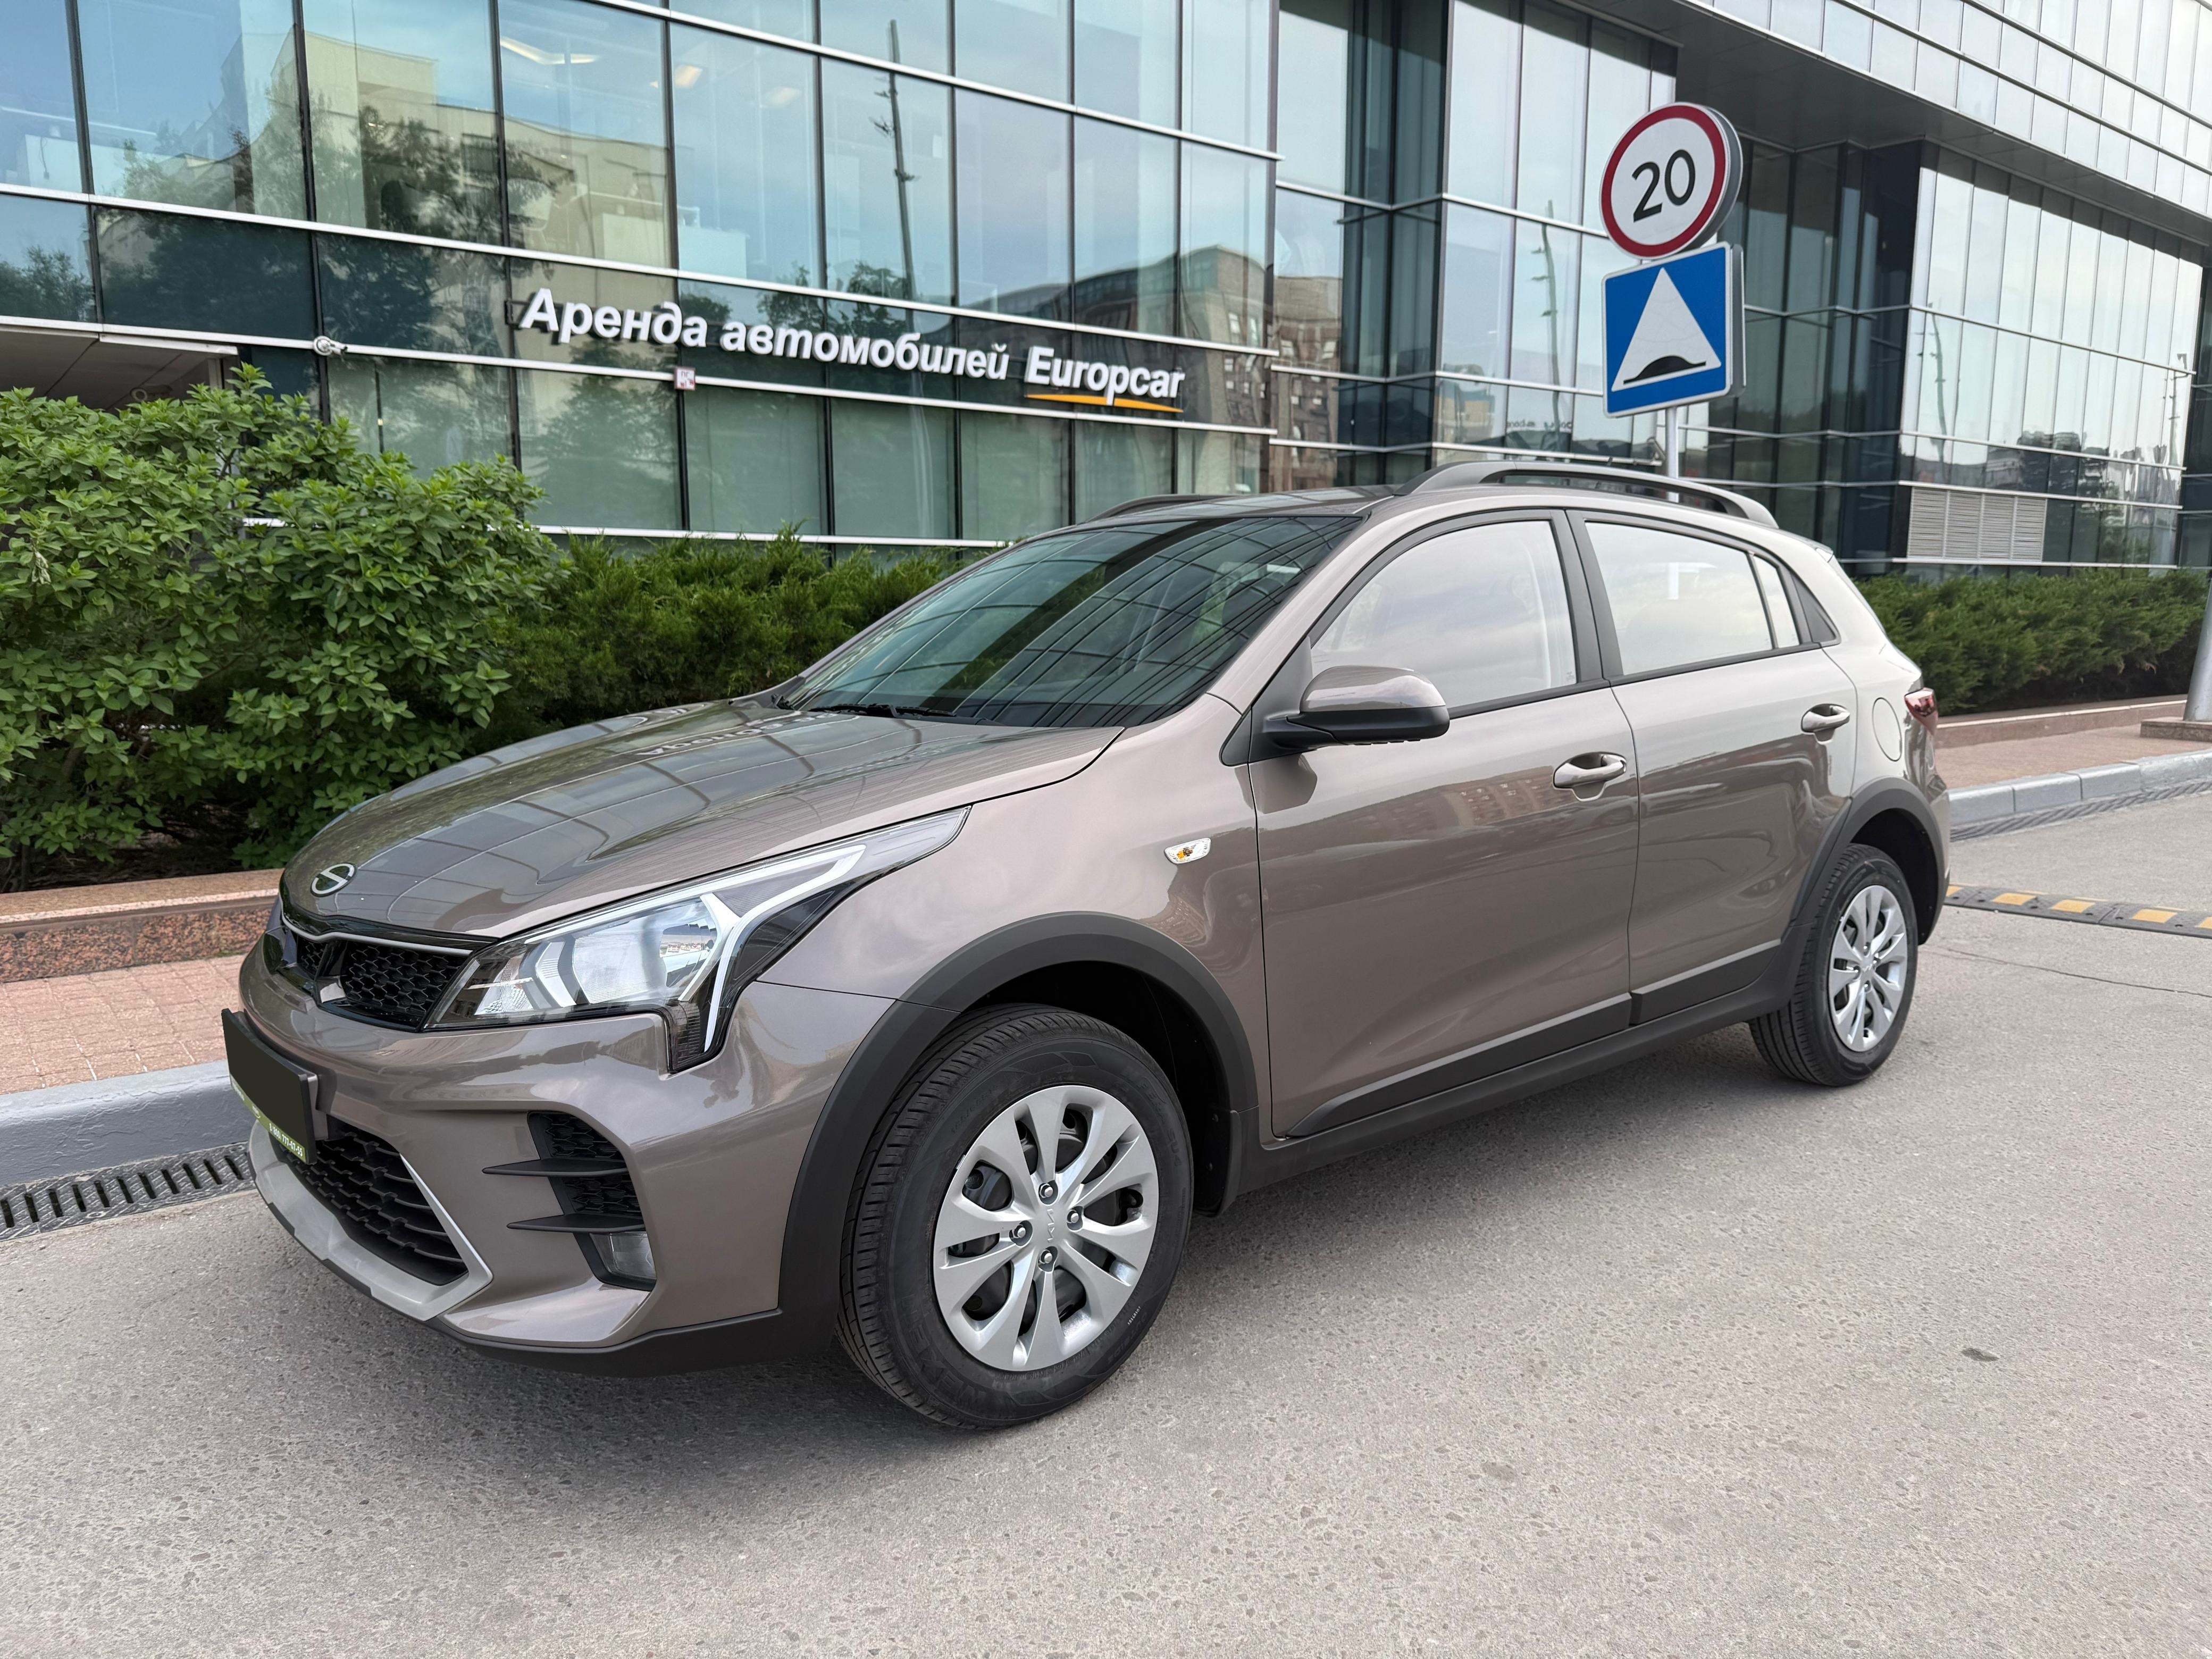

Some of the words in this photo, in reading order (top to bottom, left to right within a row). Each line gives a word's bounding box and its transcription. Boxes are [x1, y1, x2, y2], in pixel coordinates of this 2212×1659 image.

[1632, 149, 1696, 223] 20
[518, 288, 708, 348] Аренда
[719, 321, 1010, 380] автомобилей
[1024, 346, 1186, 406] Europcar
